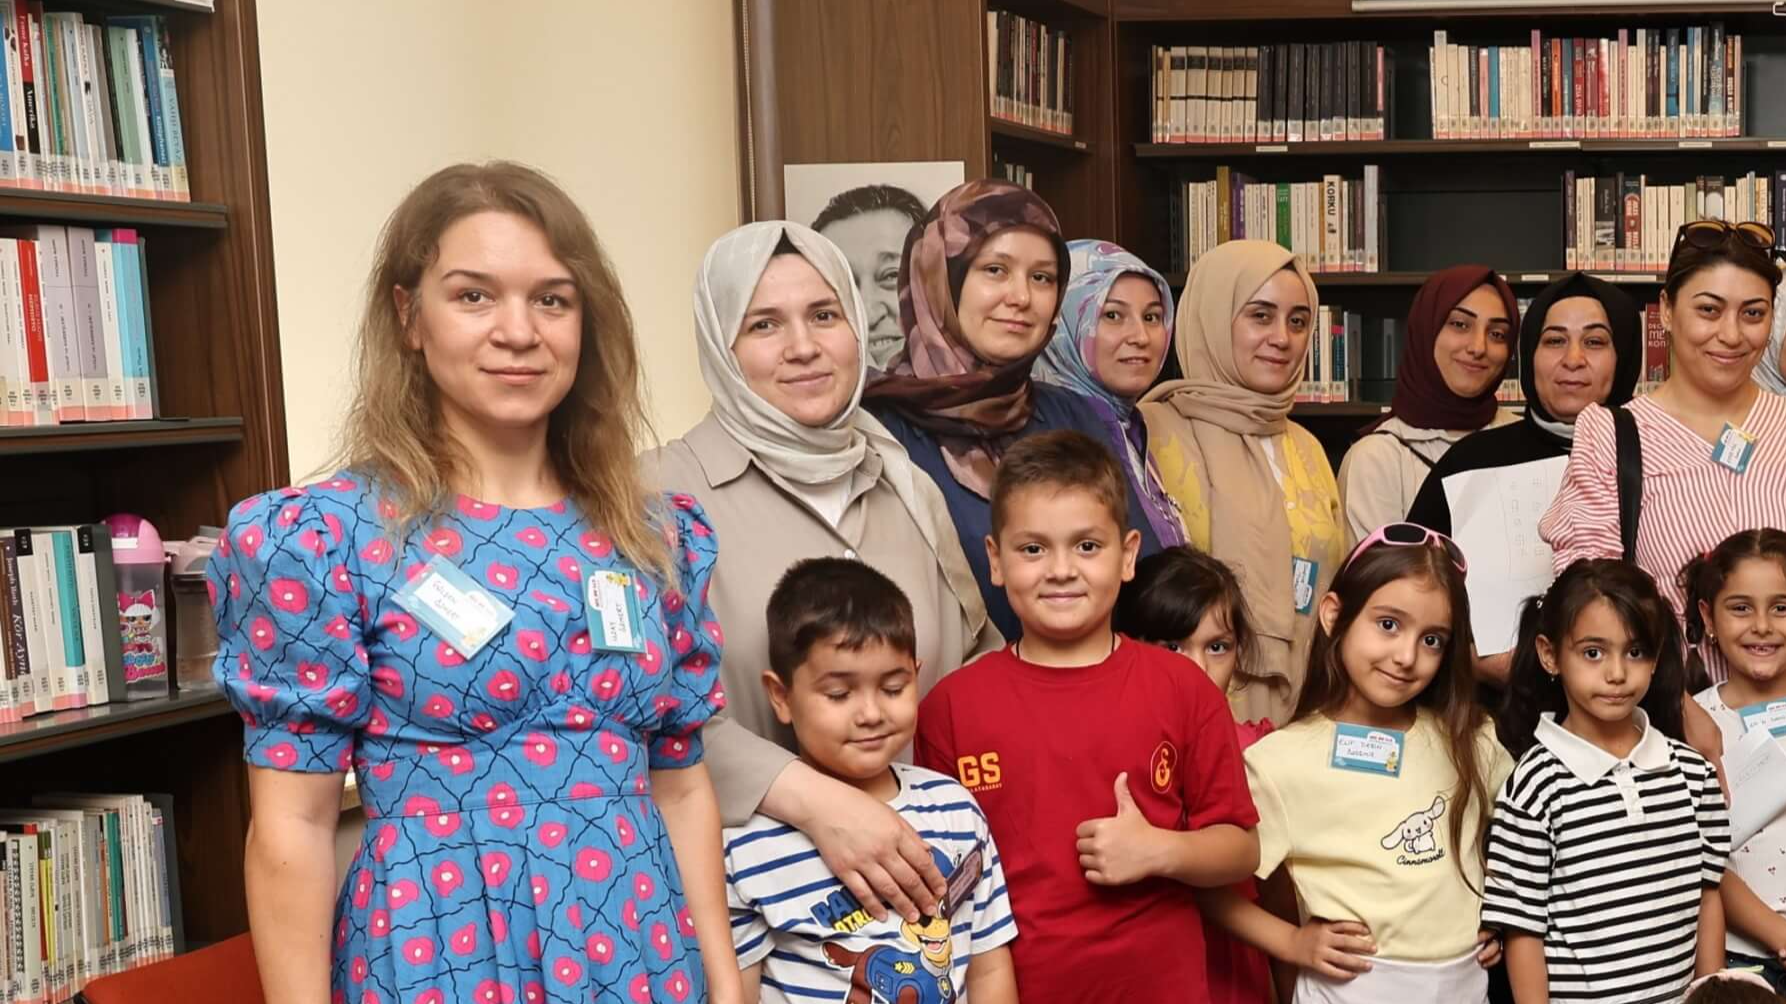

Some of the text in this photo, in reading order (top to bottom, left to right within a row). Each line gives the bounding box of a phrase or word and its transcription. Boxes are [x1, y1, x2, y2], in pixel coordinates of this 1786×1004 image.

[25, 88, 36, 130] Amerika
[1326, 180, 1337, 217] KORKU
[12, 613, 24, 641] Kör
[957, 751, 1001, 787] GS
[970, 783, 1003, 793] LATASARAY
[810, 885, 860, 928] PA
